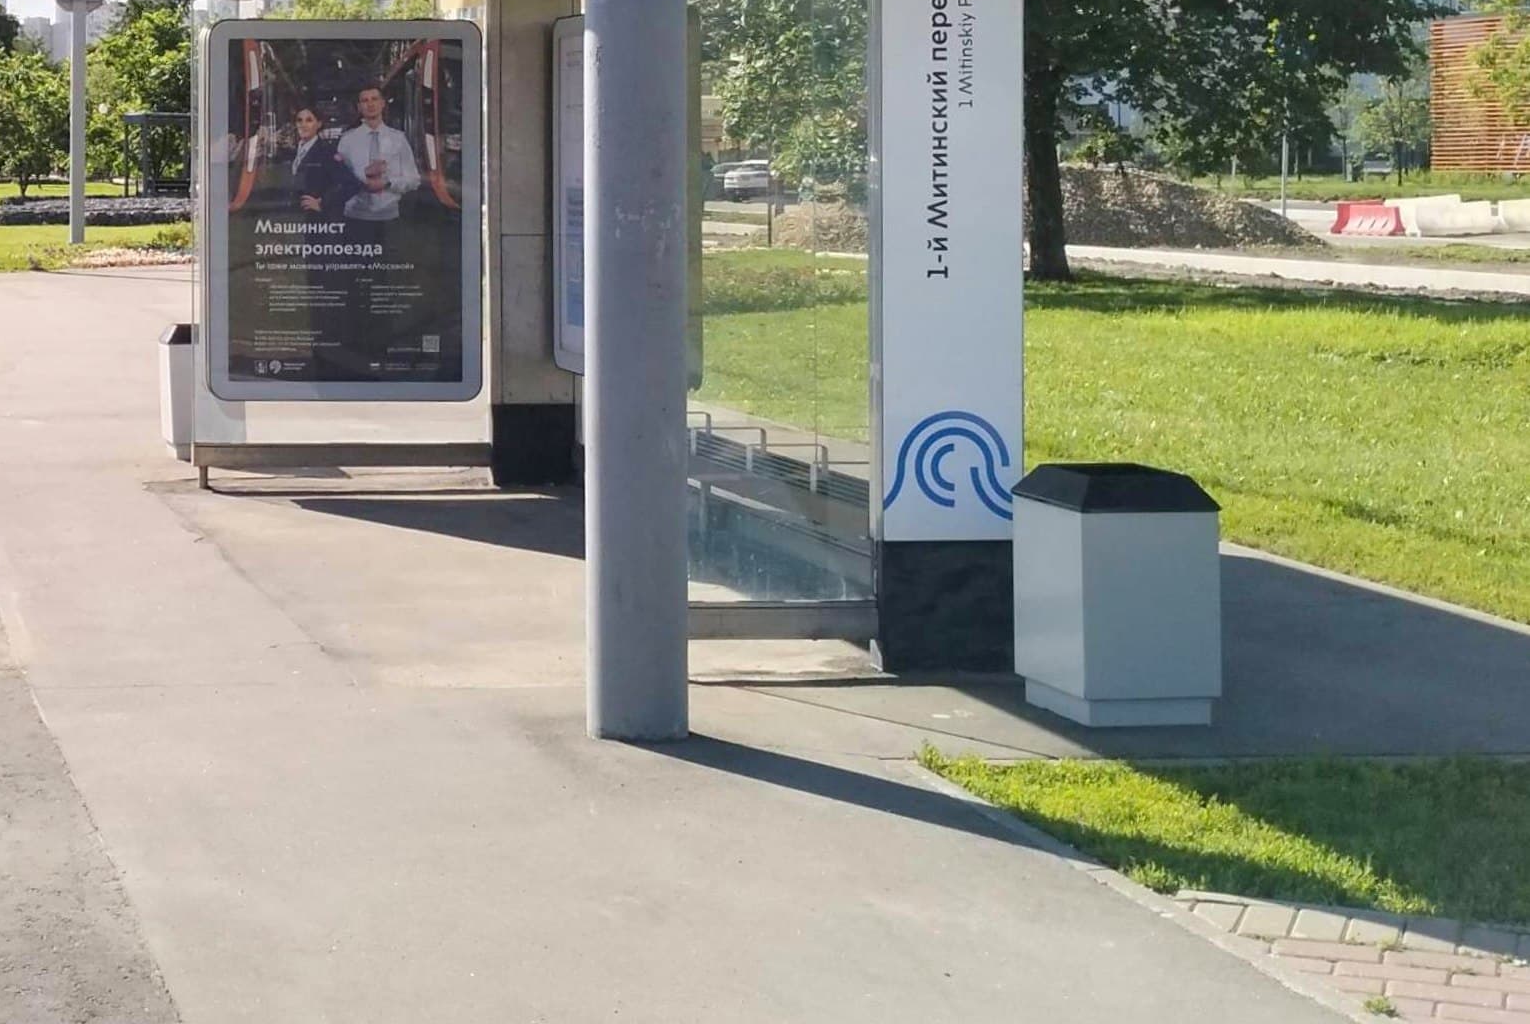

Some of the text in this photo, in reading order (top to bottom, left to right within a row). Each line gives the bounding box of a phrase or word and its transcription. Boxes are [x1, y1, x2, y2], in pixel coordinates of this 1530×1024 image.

[957, 12, 976, 95] Mitinskiy
[958, 98, 973, 108] 1
[926, 71, 949, 229] Митинский
[254, 219, 346, 234] Машинист
[254, 243, 383, 259] электропоезда
[926, 237, 949, 279] 1-й
